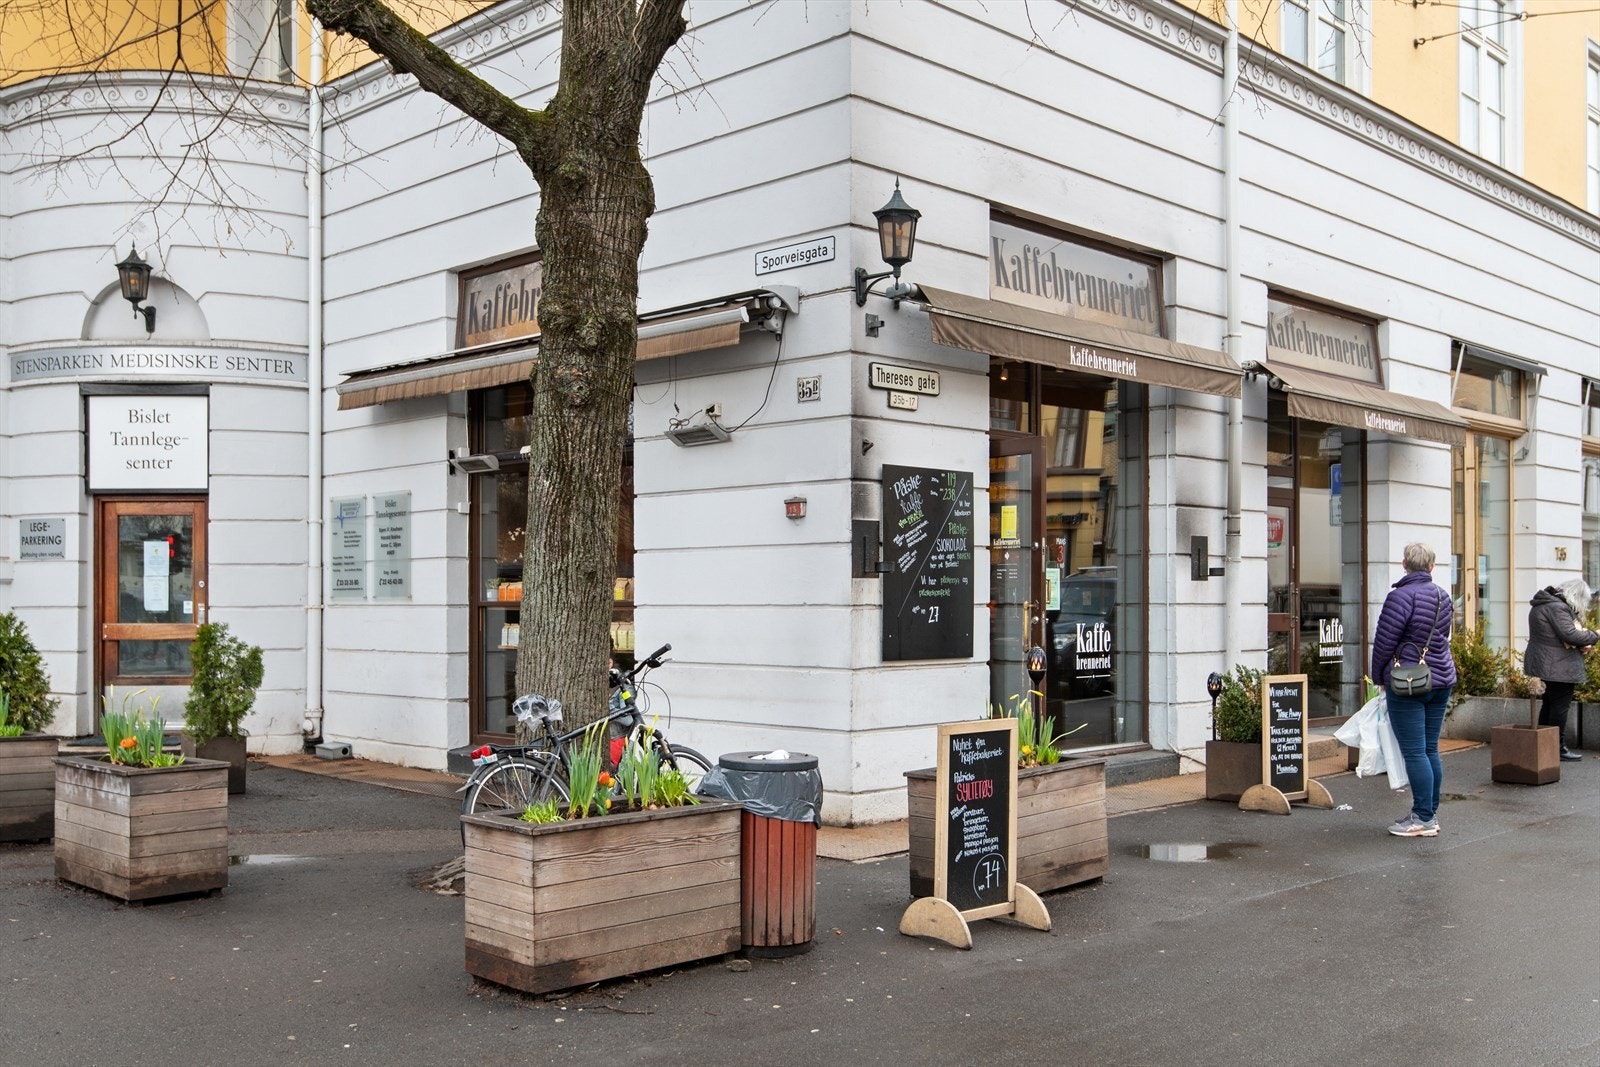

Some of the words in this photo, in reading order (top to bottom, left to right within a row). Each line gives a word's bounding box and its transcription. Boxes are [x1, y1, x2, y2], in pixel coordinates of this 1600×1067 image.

[762, 245, 828, 270] Sporveisgata
[991, 235, 1154, 323] Kaffebrenneriet
[1268, 311, 1374, 370] Kaffebrenneriet
[15, 353, 104, 375] STENSPARKEN
[110, 353, 219, 370] MEDISINSKE
[225, 356, 295, 375] SENTER
[1069, 345, 1137, 377] Kaffebrenneriet
[876, 367, 914, 387] Thereses
[917, 375, 936, 391] gate
[127, 409, 171, 424] Bislet
[1364, 410, 1407, 434] Kaffebrenneriet
[110, 431, 190, 450] Tannlege-
[126, 457, 173, 470] senter
[947, 472, 956, 487] 119
[943, 488, 956, 502] 238
[30, 522, 51, 533] LEGE-
[21, 535, 63, 546] PARKERING
[928, 606, 939, 623] 27
[1076, 622, 1112, 653] Kaffe
[1319, 618, 1344, 644] Kaffe
[1076, 654, 1112, 671] brenneriet
[953, 738, 972, 756] Nyhet
[956, 779, 993, 802] SYLTETØY
[982, 860, 1001, 889] 74
